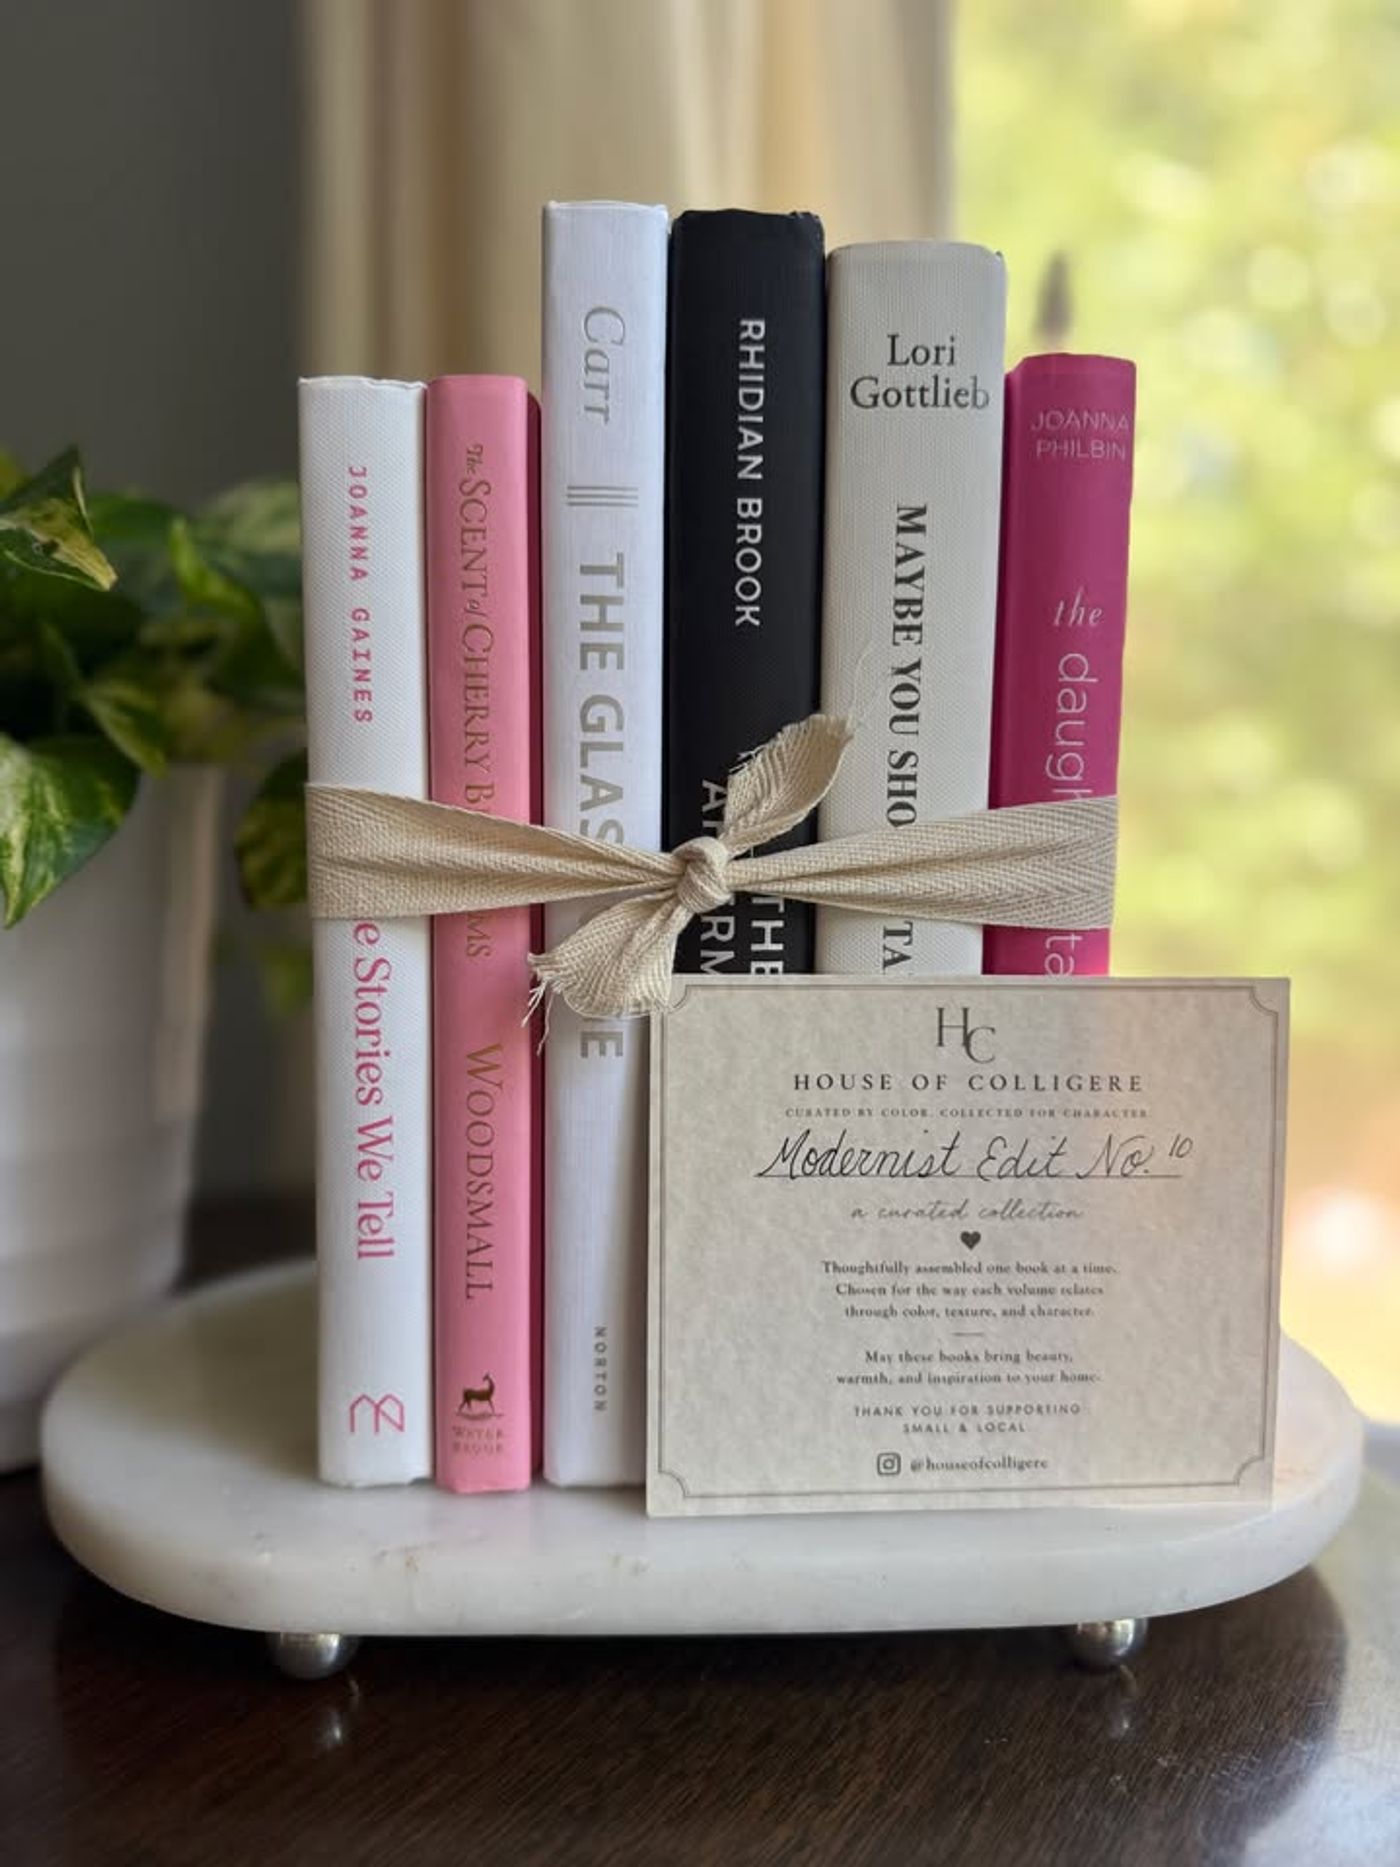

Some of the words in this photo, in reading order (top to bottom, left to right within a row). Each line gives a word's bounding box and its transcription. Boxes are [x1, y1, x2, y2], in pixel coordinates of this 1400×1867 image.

[583, 306, 625, 424] Carr
[887, 333, 956, 367] Lori
[737, 318, 766, 481] RHIDIAN
[849, 375, 991, 411] Gottlieb
[1030, 409, 1130, 434] JOANNA
[1035, 438, 1126, 461] PHILBIN
[464, 442, 484, 477] The
[347, 465, 370, 583] JOANNA
[458, 479, 489, 598] SCENT
[734, 497, 763, 628] BROOK
[890, 503, 927, 648] MAYBE
[579, 552, 624, 671] THE
[1052, 587, 1103, 627] the
[350, 607, 373, 725] GAINES
[460, 622, 495, 775] CHERRY
[888, 657, 922, 737] YOU
[579, 694, 625, 846] GLAS
[885, 750, 920, 828] SHO
[353, 956, 393, 1107] Stories
[937, 1006, 996, 1065] HC
[794, 1073, 892, 1091] HOUSE
[912, 1073, 948, 1091] OF
[967, 1073, 1144, 1092] COLLIGERE
[785, 1107, 851, 1118] CURATED
[857, 1107, 874, 1118] BY
[940, 1107, 1023, 1118] COLLECTED
[1029, 1108, 1056, 1118] FOR
[356, 1114, 396, 1184] We
[464, 1042, 505, 1300] WOODSMALL
[757, 1128, 961, 1180] Modernist
[976, 1135, 1068, 1182] Edit
[1168, 1133, 1194, 1158] 10
[357, 1190, 396, 1261] Tell
[850, 1206, 870, 1219] a
[877, 1198, 970, 1221] curated
[977, 1198, 1085, 1221] collection
[821, 1260, 910, 1276] Thoughtfully
[914, 1261, 983, 1275] assembled
[986, 1264, 1011, 1275] one
[1015, 1261, 1048, 1274] book
[1053, 1263, 1066, 1274] at
[835, 1283, 887, 1296] Chosen
[891, 1283, 911, 1296] for
[916, 1283, 937, 1296] the
[941, 1285, 967, 1298] way
[971, 1283, 1002, 1296] each
[1006, 1283, 1055, 1296] volume
[1060, 1283, 1104, 1296] relates
[845, 1305, 898, 1319] through
[1001, 1304, 1026, 1317] and
[594, 1325, 609, 1412] NORTON
[865, 1351, 892, 1364] May
[898, 1350, 935, 1363] these
[938, 1350, 981, 1363] books
[983, 1350, 1021, 1364] bring
[898, 1372, 923, 1384] and
[927, 1372, 1002, 1386] inspiration
[1006, 1373, 1021, 1384] to
[1024, 1373, 1055, 1385] your
[854, 1405, 903, 1417] THANK
[912, 1405, 943, 1416] YOU
[950, 1405, 979, 1416] FOR
[987, 1403, 1082, 1416] SUPPORTING
[903, 1423, 949, 1434] SMALL
[958, 1423, 968, 1433] &
[977, 1422, 1027, 1433] LOCAL
[910, 1454, 1049, 1473] @houseofcolligere
